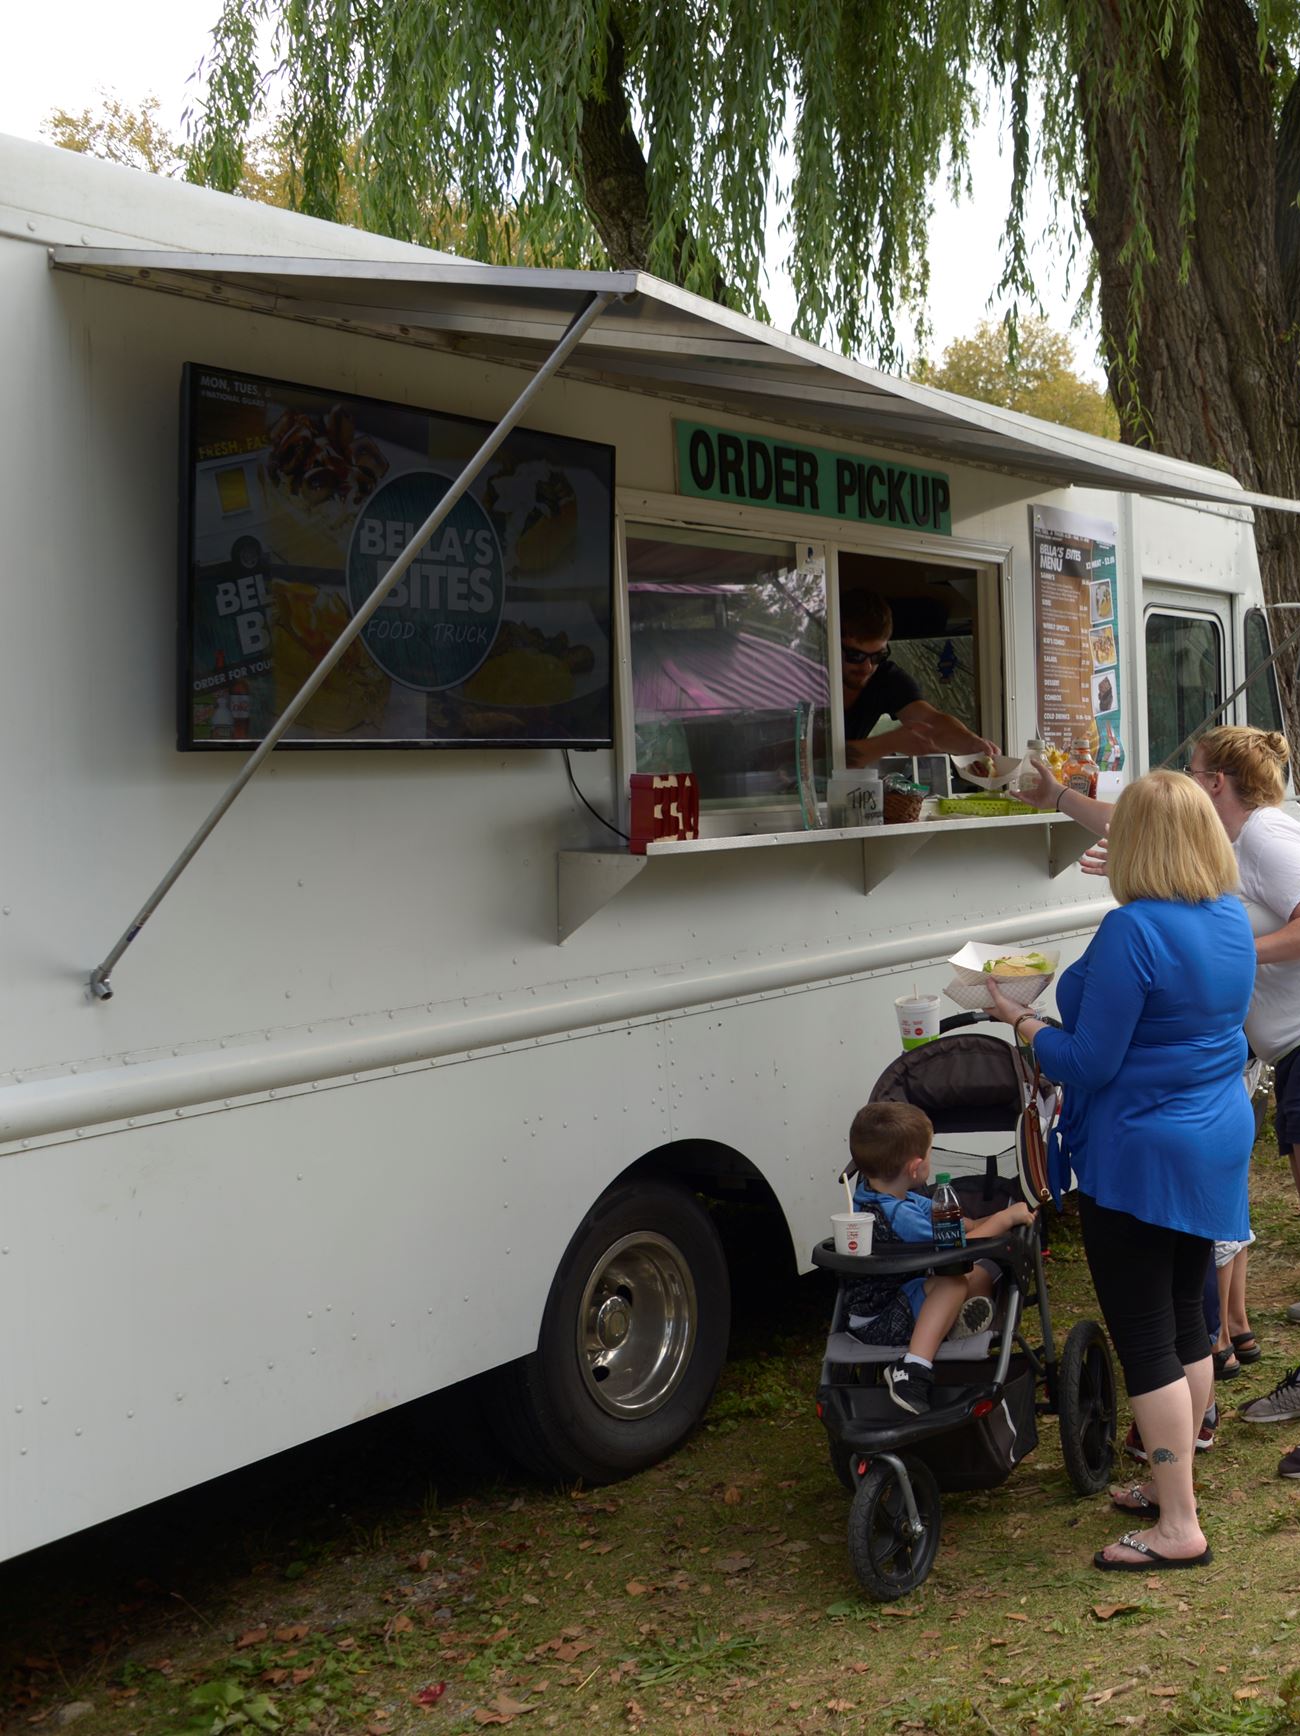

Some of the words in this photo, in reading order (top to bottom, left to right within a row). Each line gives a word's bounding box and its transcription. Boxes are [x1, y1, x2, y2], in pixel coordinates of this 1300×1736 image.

[200, 375, 231, 392] MON,
[689, 428, 820, 510] ORDER
[836, 458, 951, 530] PICKUP
[360, 518, 494, 566] BELLA'S
[1039, 543, 1064, 559] BELLA'S
[1065, 548, 1082, 562] BITES
[1040, 555, 1063, 572] MENU
[376, 560, 494, 614] BITES
[367, 621, 416, 639] FOOD
[433, 623, 488, 645] TRUCK
[193, 673, 226, 691] ORDER
[228, 666, 248, 681] FOR
[847, 787, 877, 811] TIPS
